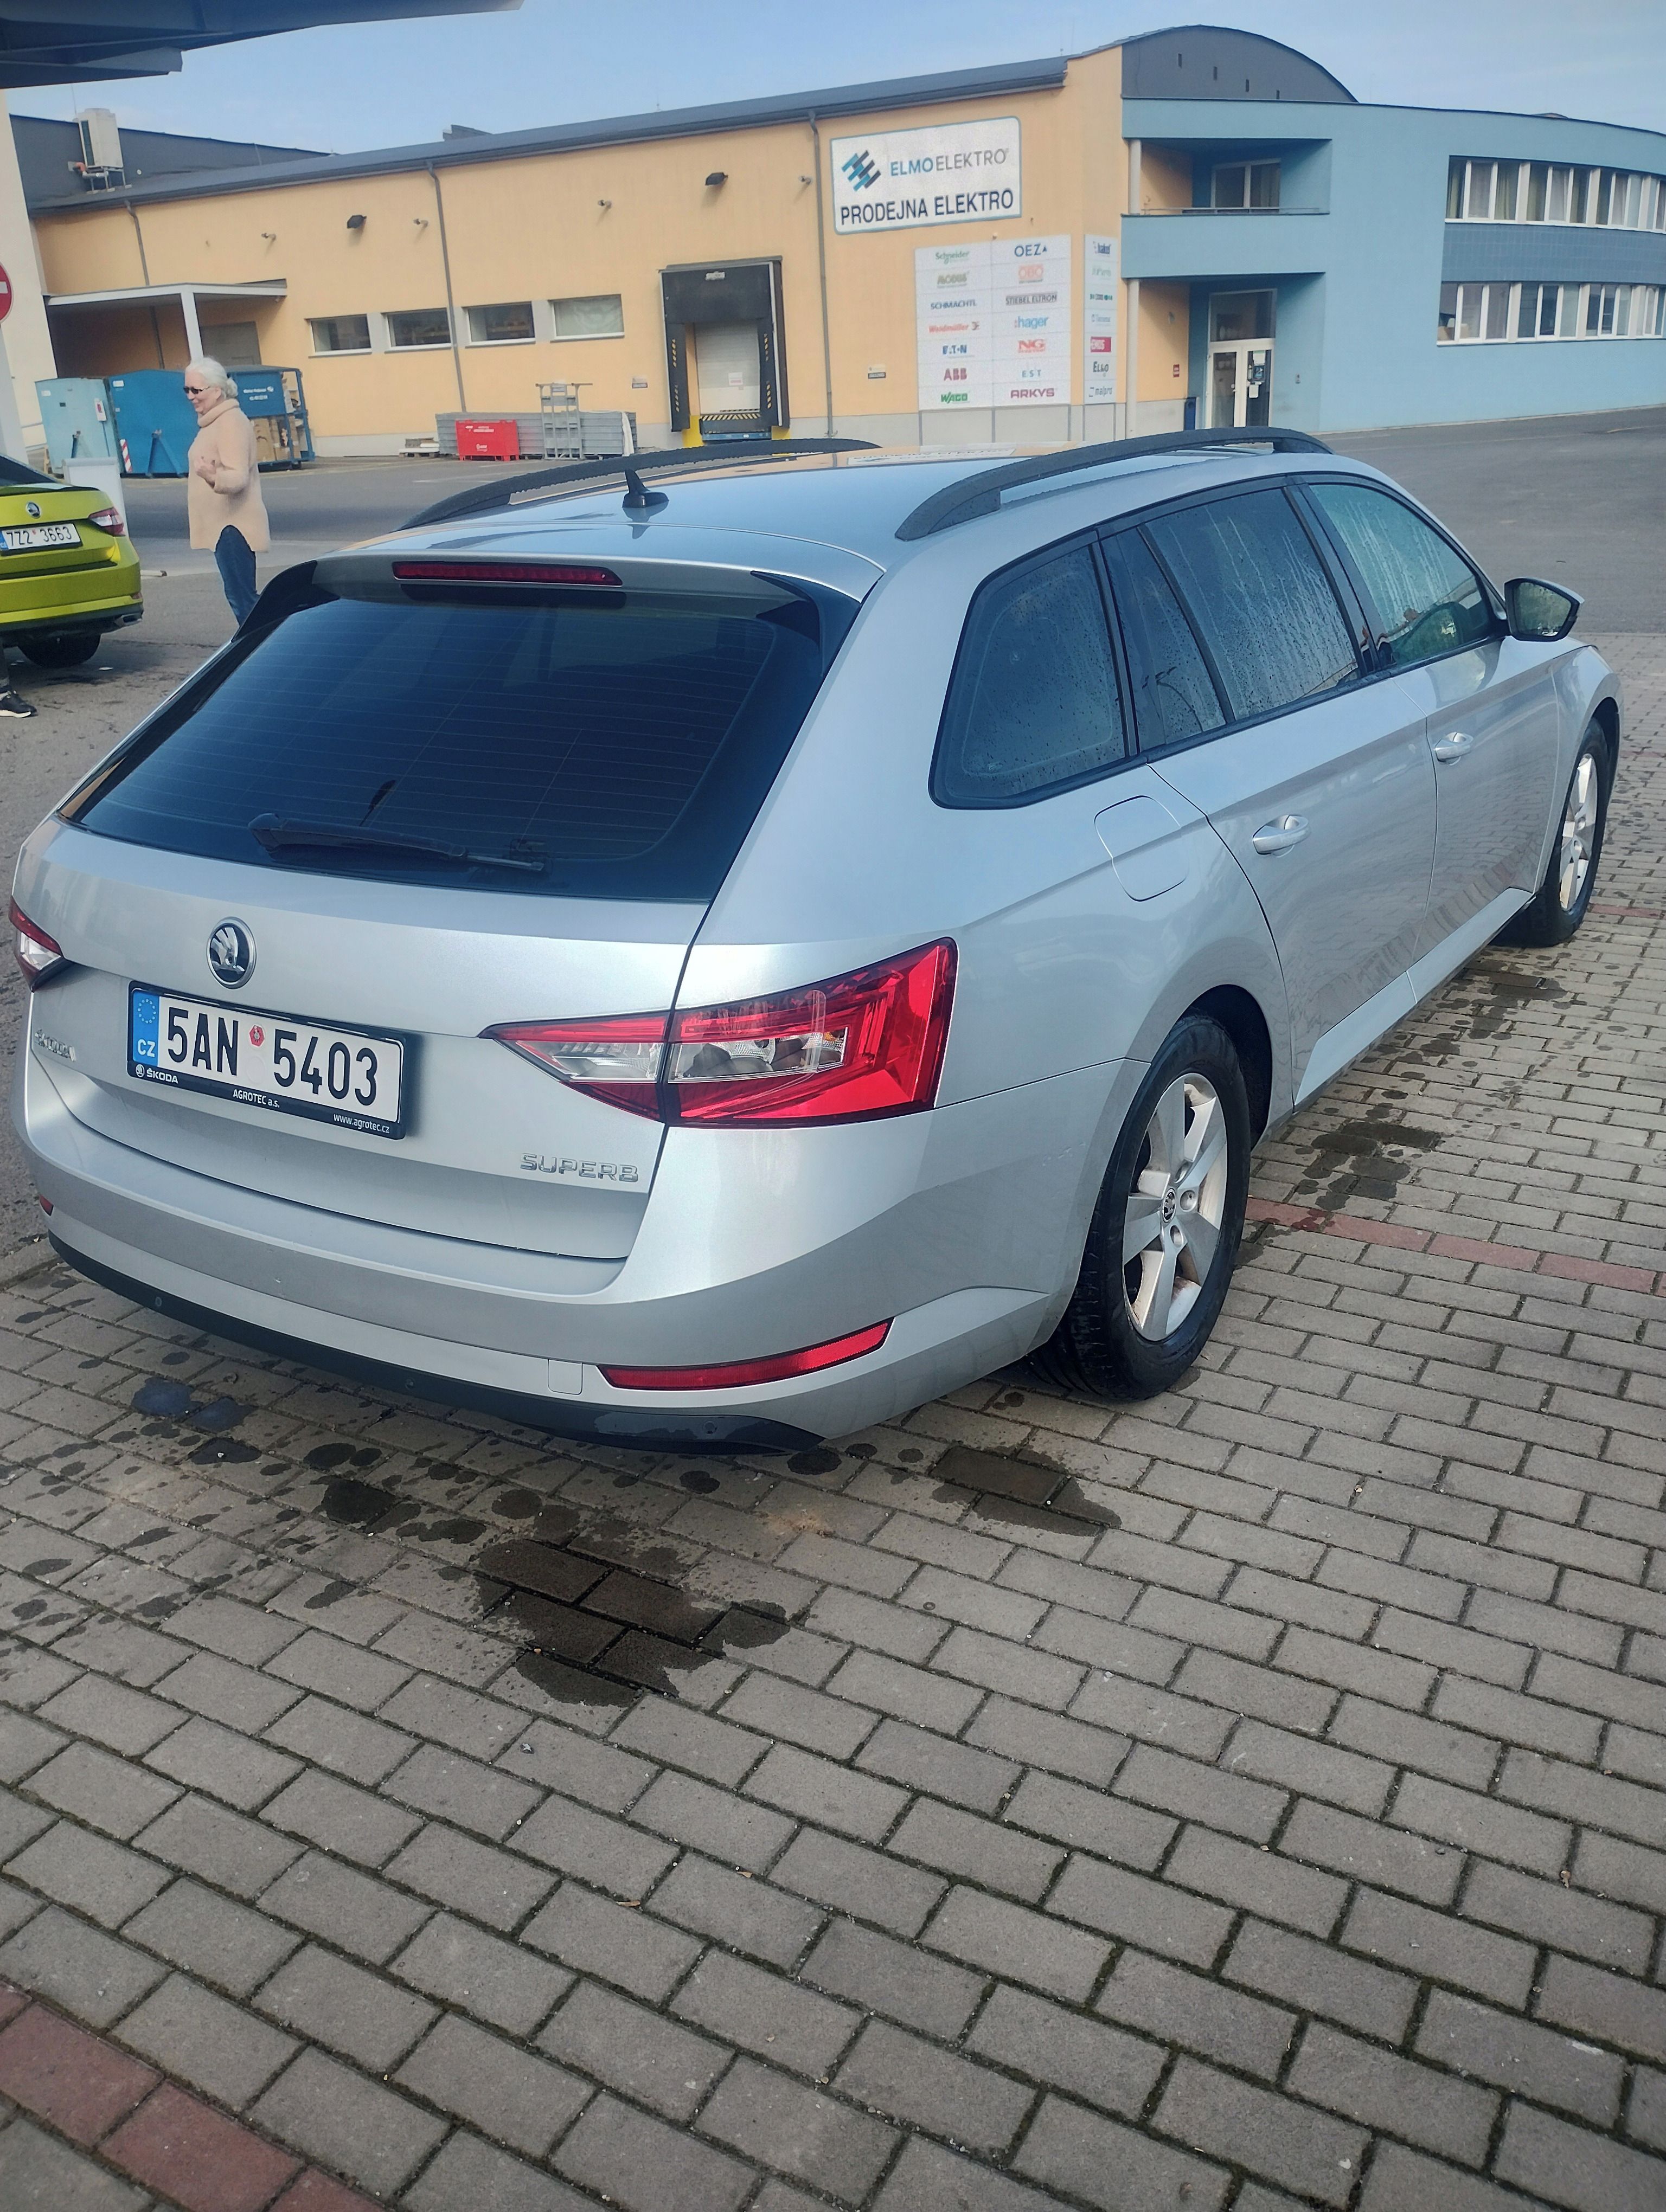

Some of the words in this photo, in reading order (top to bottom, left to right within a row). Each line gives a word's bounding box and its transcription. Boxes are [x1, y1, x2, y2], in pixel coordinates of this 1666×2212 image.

[841, 198, 928, 225] PRODEJNA
[934, 188, 1013, 216] ELEKTRO
[1014, 243, 1041, 257] OEZ
[1005, 296, 1030, 305] STIEBEL
[1032, 293, 1057, 304] ELTRON
[944, 368, 967, 381] ABB
[940, 391, 968, 404] WAGO
[1010, 388, 1055, 398] ARKYS
[40, 526, 72, 542] 3663
[137, 1038, 156, 1058] CZ
[167, 1006, 239, 1076] 5AN
[273, 1028, 378, 1106] 5403
[146, 1067, 178, 1084] ŠKODA
[233, 1089, 267, 1105] AGROTEC
[268, 1098, 280, 1108] a.s.
[334, 1113, 390, 1134] www.agrotec.cz
[520, 1153, 639, 1183] SUPERB
